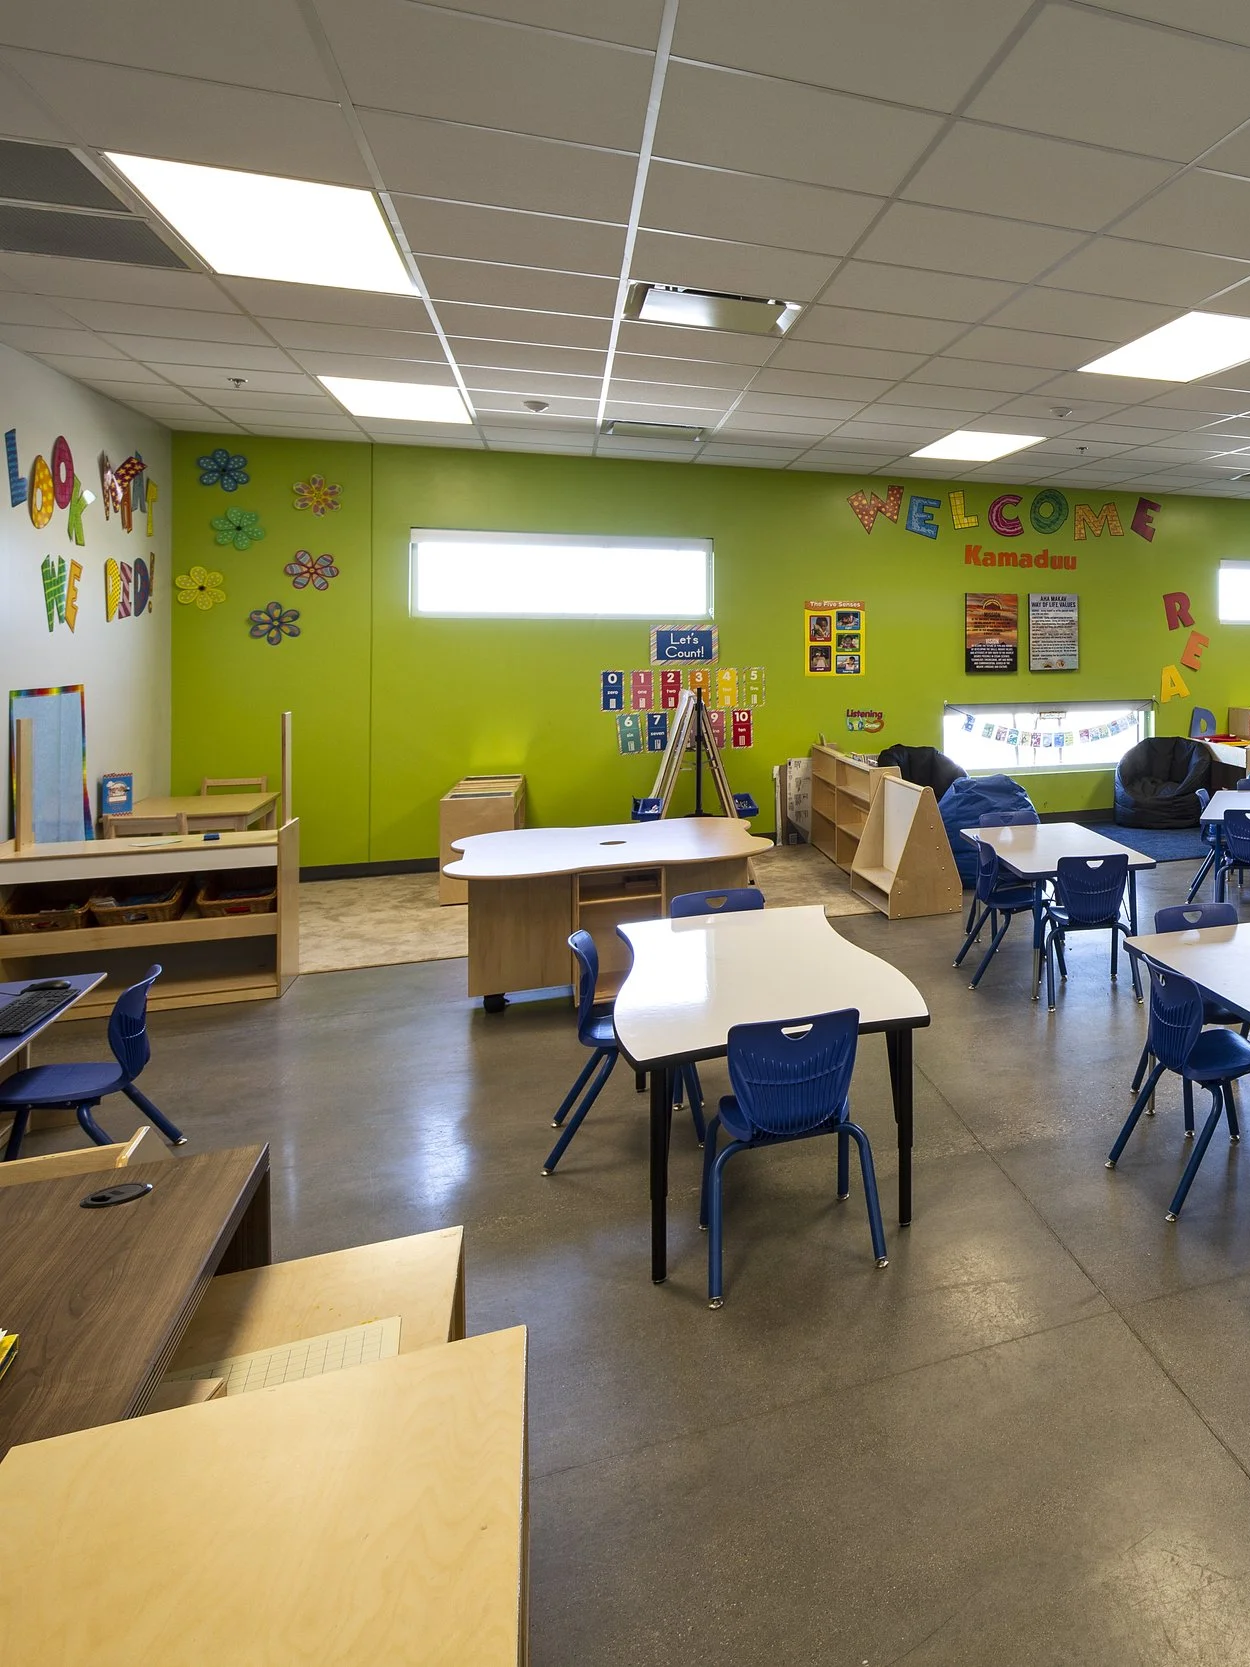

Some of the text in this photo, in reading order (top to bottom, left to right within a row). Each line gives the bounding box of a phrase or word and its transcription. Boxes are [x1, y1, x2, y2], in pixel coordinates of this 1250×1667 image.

[4, 428, 96, 547] LOOK
[846, 485, 1161, 542] WELCOME
[964, 544, 1077, 570] Kamaduu
[41, 551, 155, 633] WE DID!
[670, 632, 699, 645] Let's
[665, 646, 704, 658] Count!
[1161, 592, 1216, 737] READ
[608, 673, 617, 683] 0
[639, 673, 644, 683] 1
[667, 673, 675, 683] 2
[695, 672, 703, 682] 3
[722, 672, 731, 681] 4
[750, 671, 758, 680] 5
[711, 713, 718, 723] 9
[735, 712, 748, 722] 10
[847, 709, 883, 720] Listening
[624, 717, 632, 727] 6
[653, 715, 661, 725] 7
